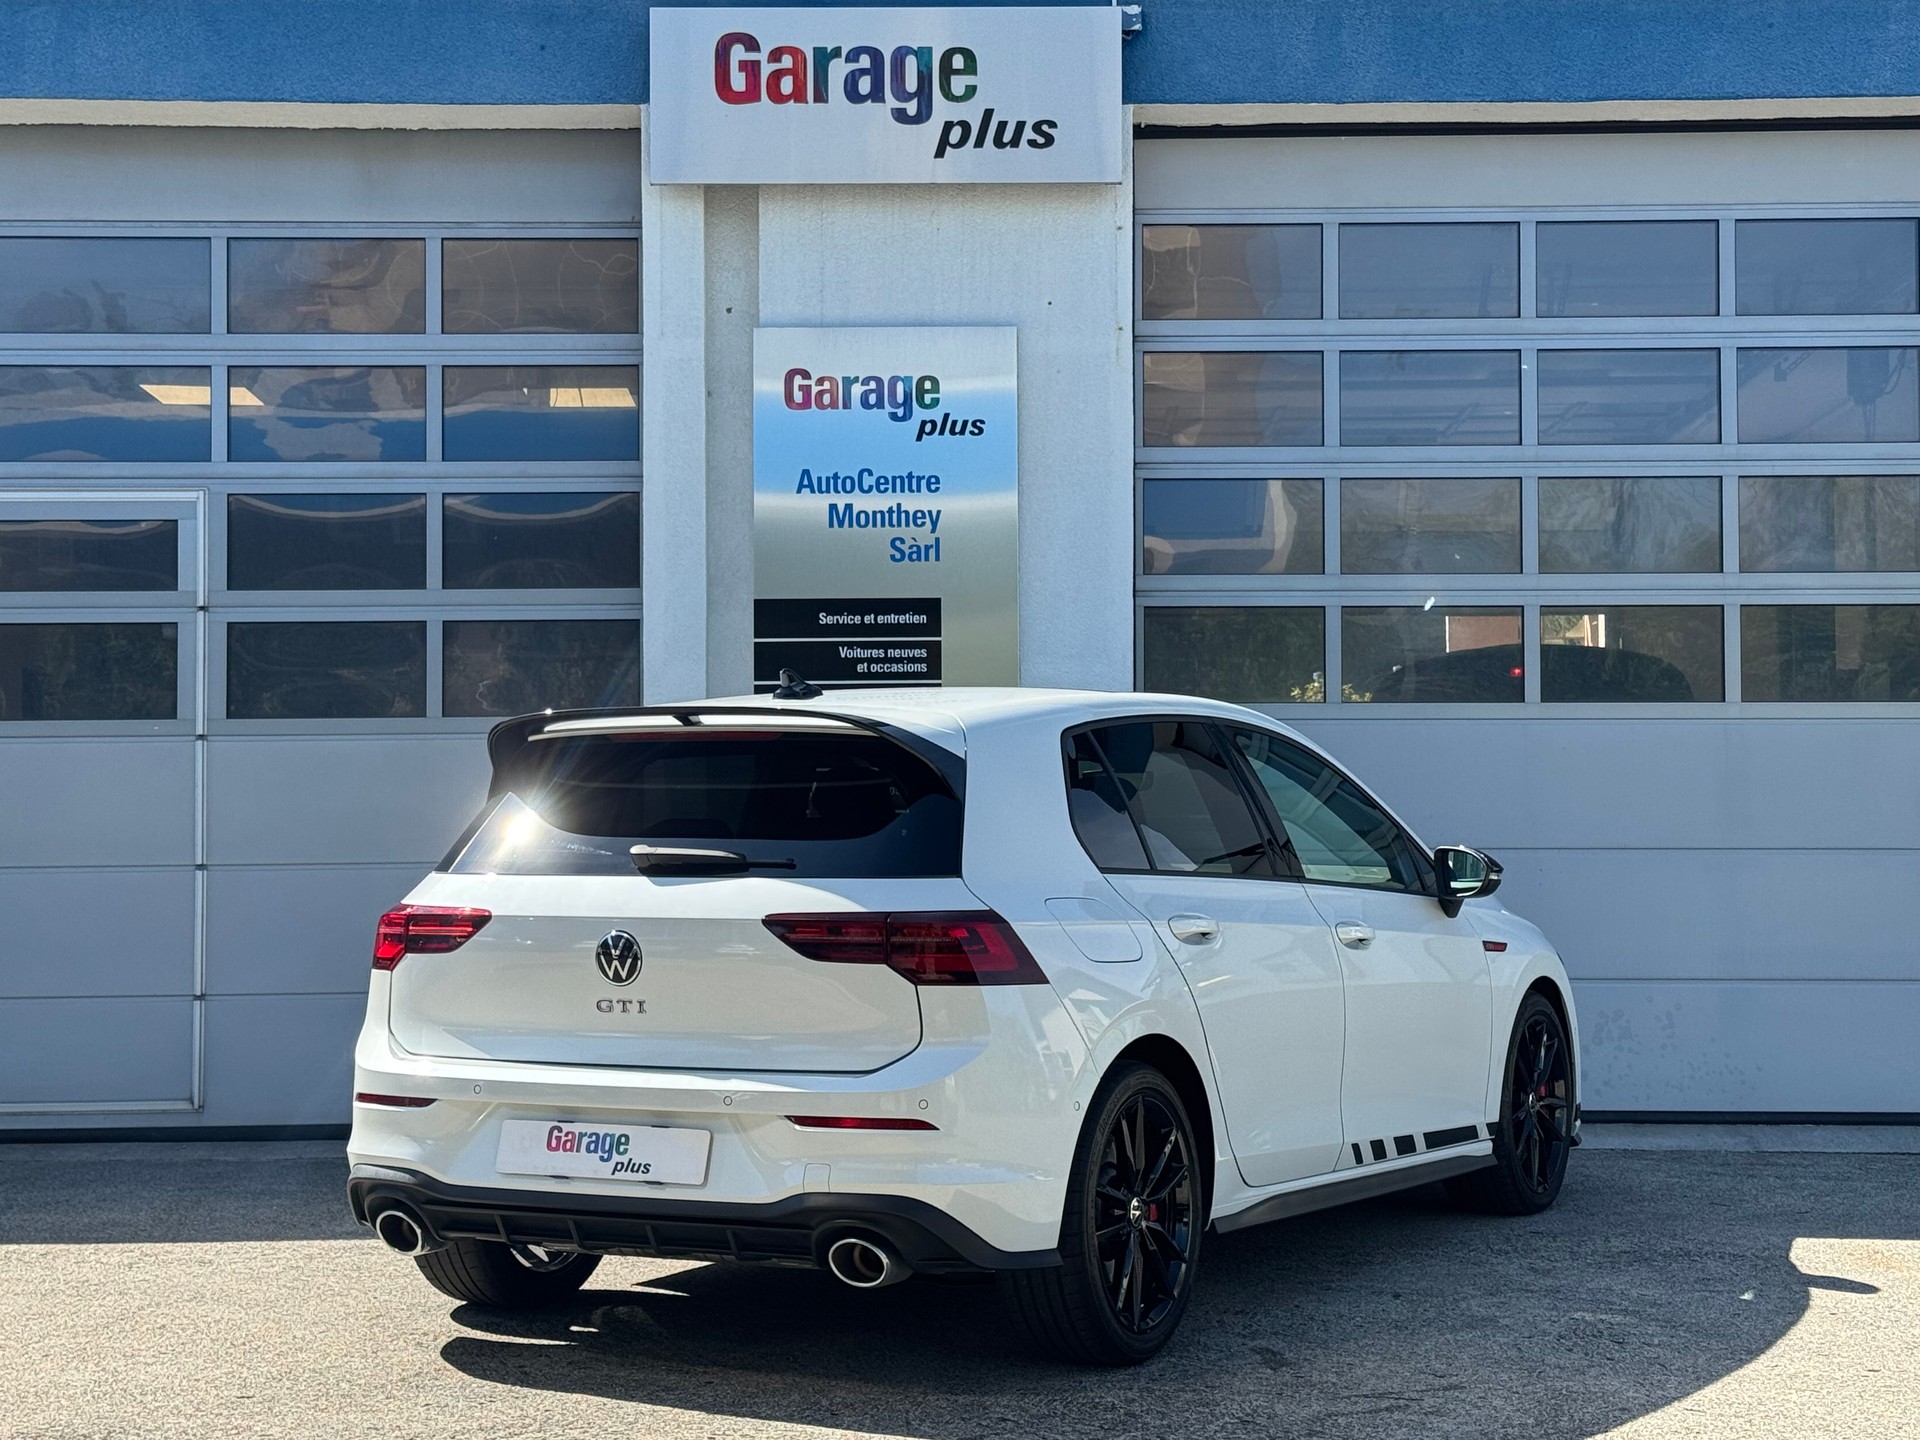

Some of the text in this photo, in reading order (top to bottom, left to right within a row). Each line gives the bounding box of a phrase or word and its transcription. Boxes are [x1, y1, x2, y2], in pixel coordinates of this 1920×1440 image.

[713, 31, 978, 125] Garage
[933, 108, 1058, 159] plus
[783, 367, 941, 422] Garage
[915, 413, 986, 442] plus
[796, 468, 941, 494] AutoCentre
[828, 503, 942, 533] Monthey
[889, 537, 941, 563] Sàrl
[818, 611, 927, 625] Service et entretien
[839, 646, 928, 659] Voitures neuves
[856, 660, 928, 673] et occasions
[596, 998, 647, 1014] GTI
[546, 1125, 631, 1162] Garage
[611, 1158, 652, 1175] plus
